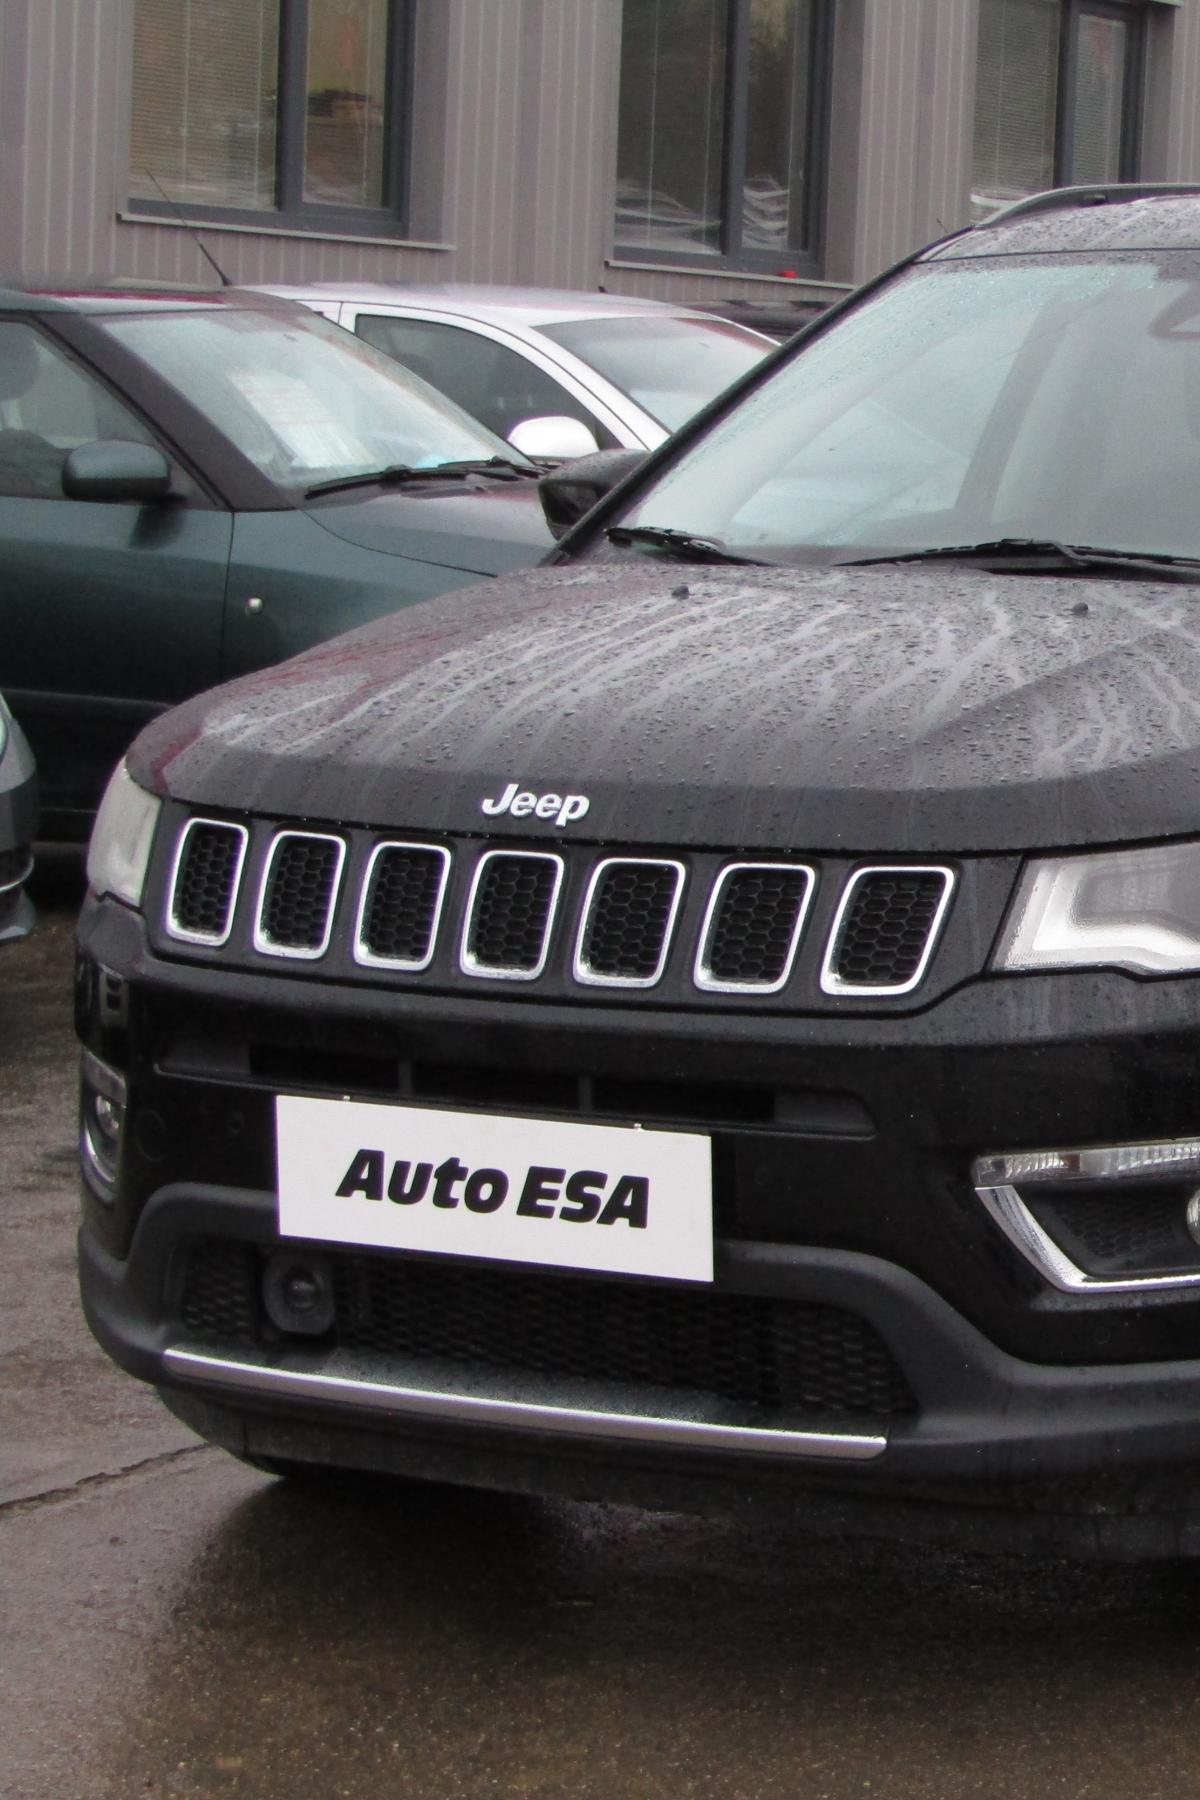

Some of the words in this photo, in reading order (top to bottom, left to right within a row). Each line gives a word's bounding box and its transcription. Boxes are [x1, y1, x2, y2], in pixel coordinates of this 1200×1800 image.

[482, 783, 590, 828] Jeep
[335, 1148, 509, 1214] Auto
[516, 1165, 650, 1229] ESA
